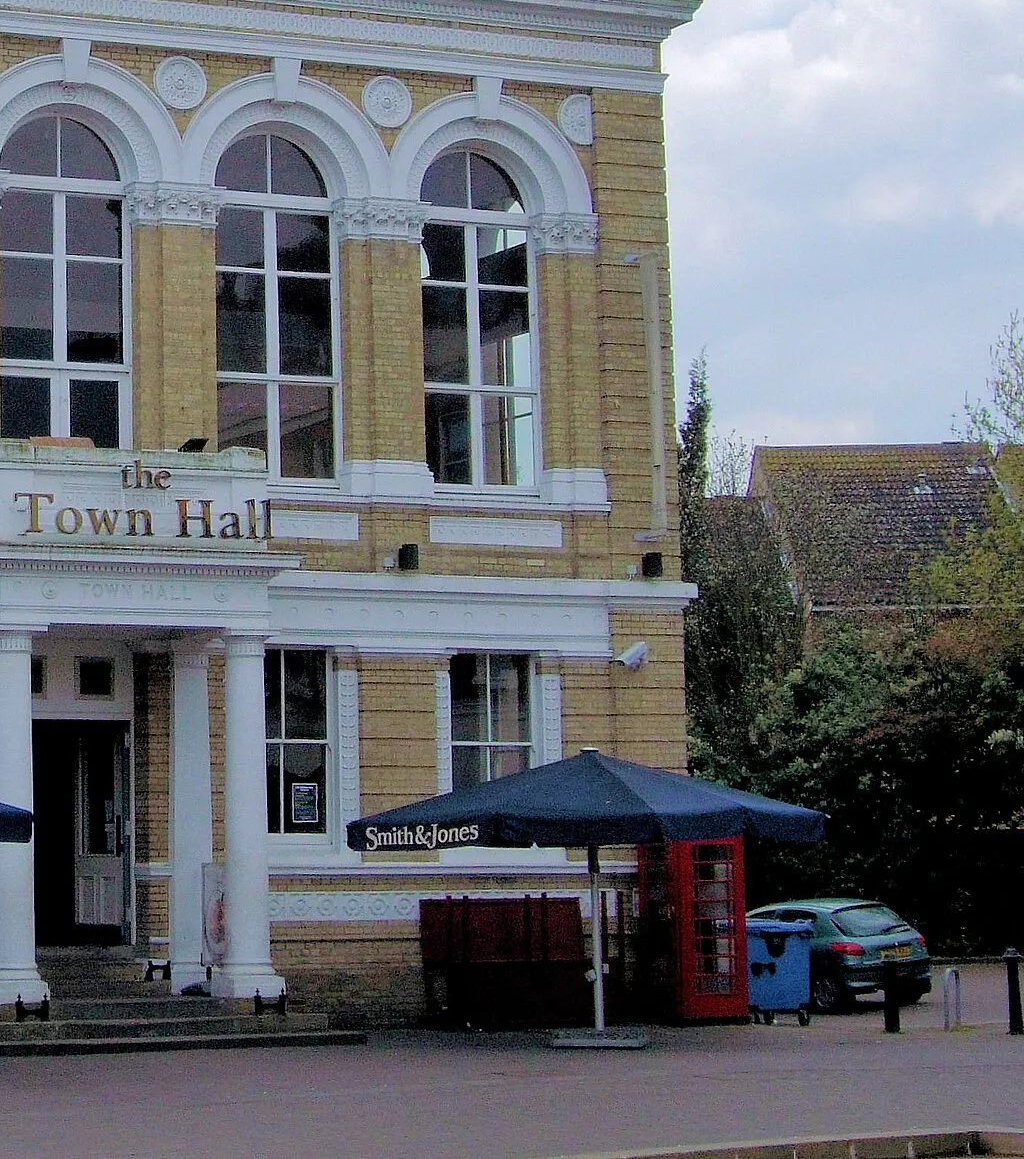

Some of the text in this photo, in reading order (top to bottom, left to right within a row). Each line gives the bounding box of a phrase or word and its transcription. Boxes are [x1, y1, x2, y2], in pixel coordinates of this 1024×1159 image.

[121, 459, 172, 490] the
[14, 492, 274, 539] Town Hall
[79, 582, 192, 601] TOWN HALL
[365, 823, 479, 850] Smith&Jones
